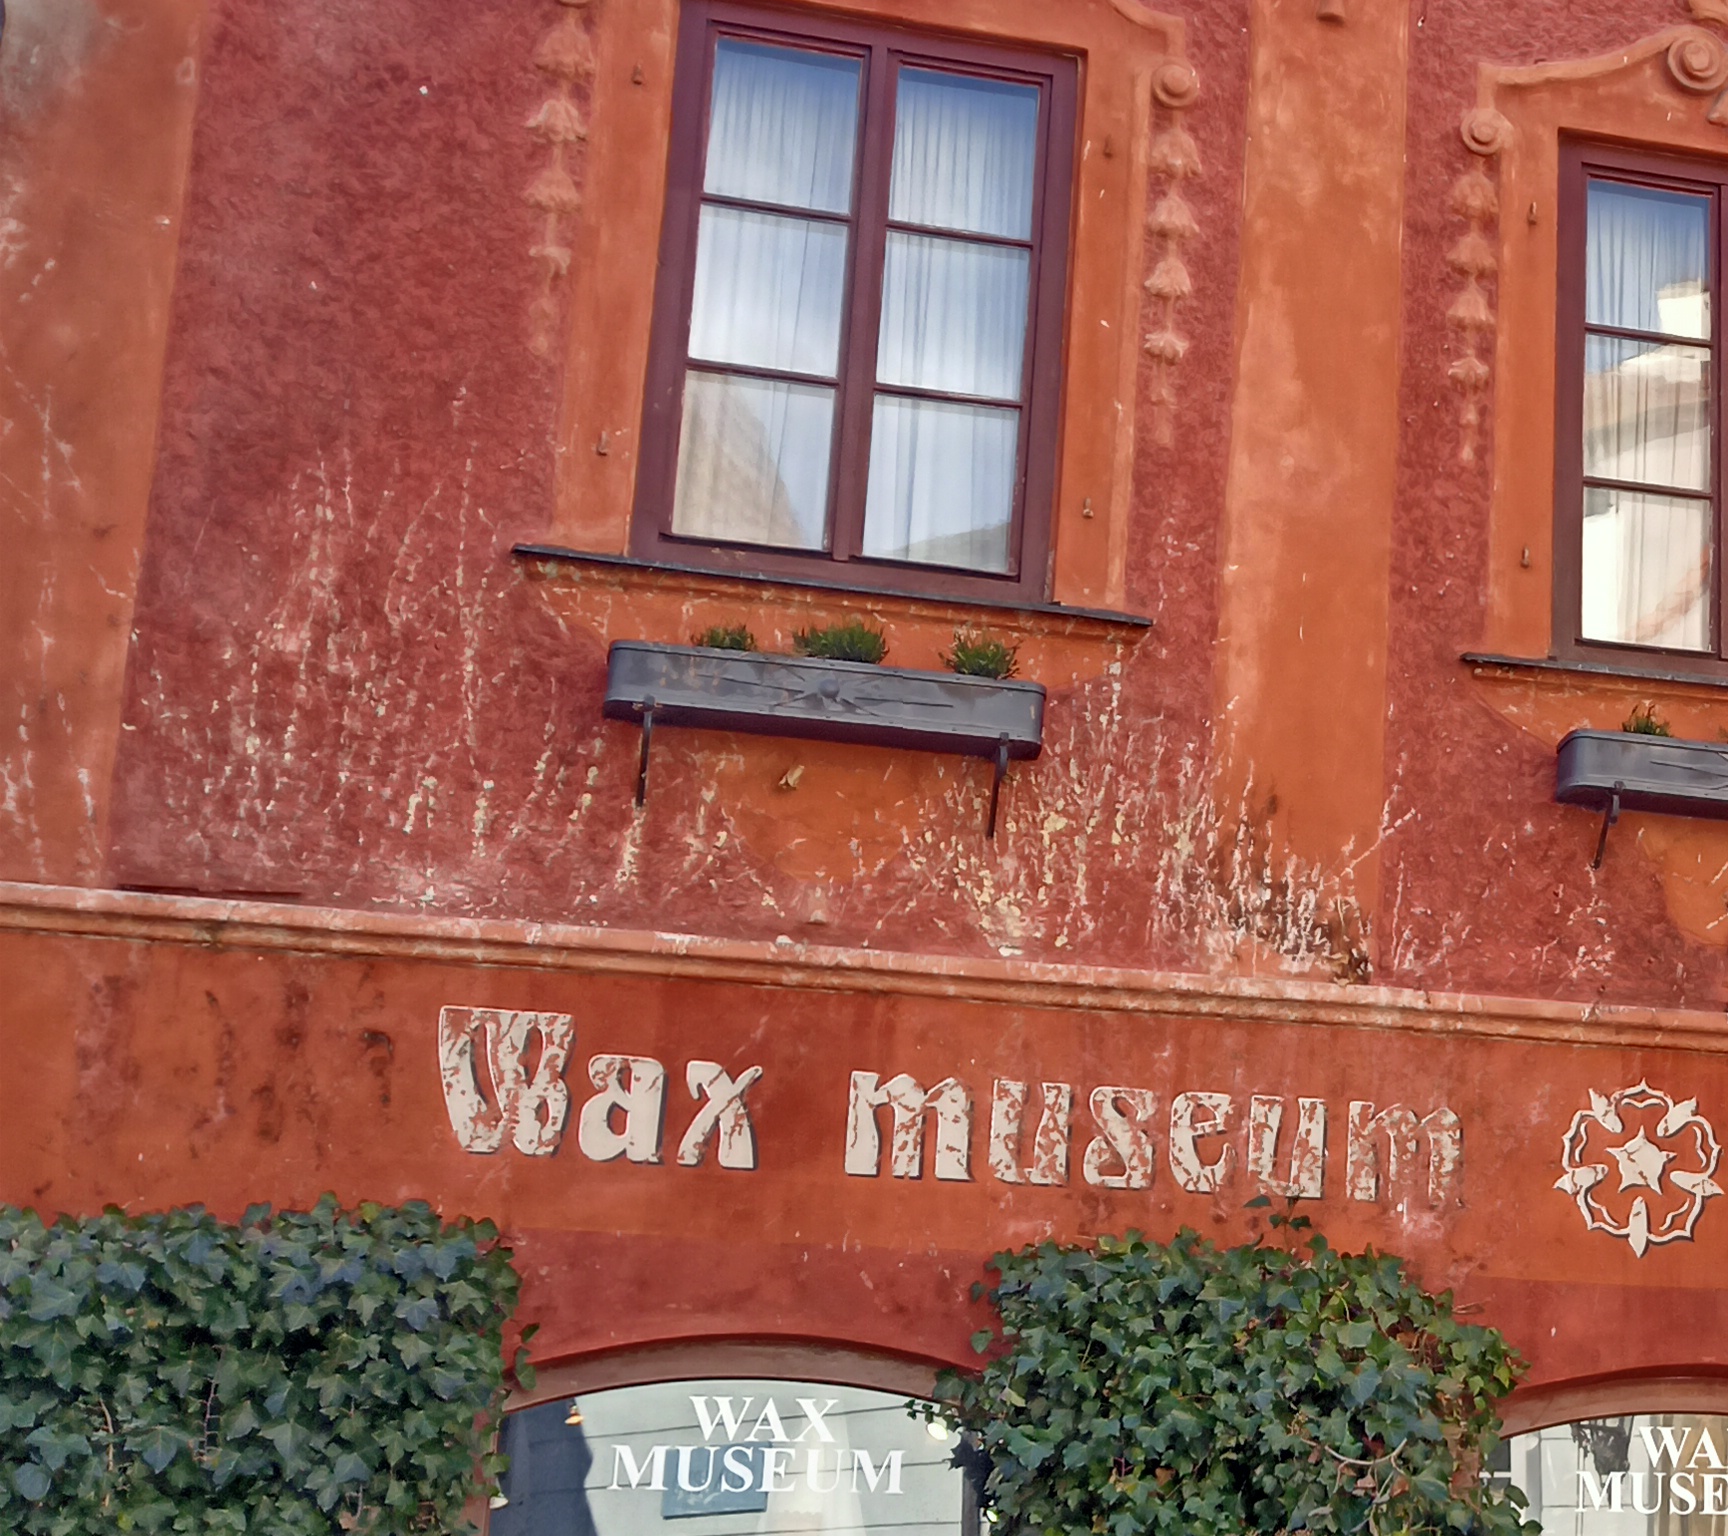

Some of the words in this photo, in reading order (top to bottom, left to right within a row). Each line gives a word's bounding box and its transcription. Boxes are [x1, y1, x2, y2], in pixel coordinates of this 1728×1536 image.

[438, 1005, 763, 1171] Wax
[844, 1069, 1464, 1208] museum
[689, 1395, 839, 1443] WAX
[606, 1444, 906, 1494] MUSEUM
